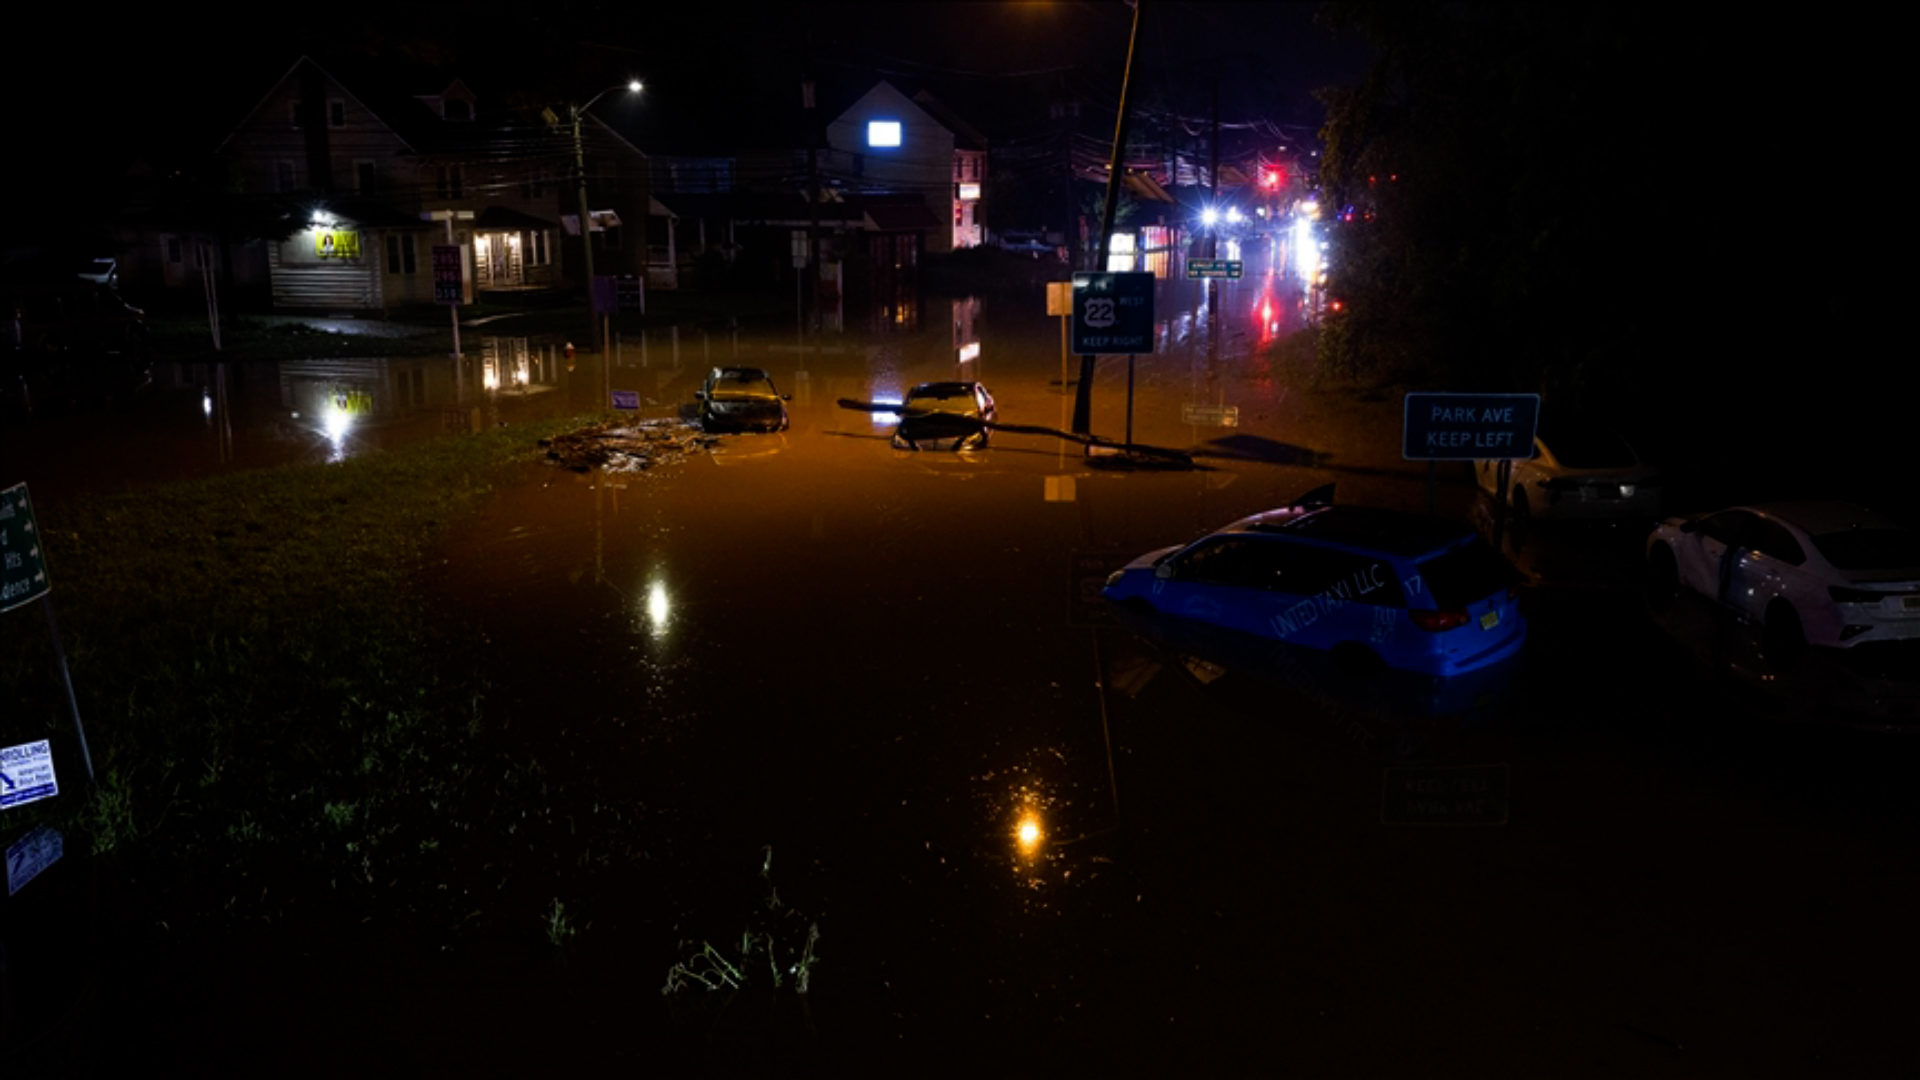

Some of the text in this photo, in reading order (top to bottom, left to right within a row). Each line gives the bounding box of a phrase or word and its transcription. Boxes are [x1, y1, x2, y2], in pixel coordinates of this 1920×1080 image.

[1119, 296, 1144, 307] WEST
[1087, 303, 1112, 321] 22
[1082, 336, 1143, 347] KEEP RIGHT
[1431, 404, 1514, 424] PARK AVE
[1426, 430, 1515, 448] KEEP LEFT
[1404, 574, 1422, 597] 17
[1269, 563, 1386, 639] UNITED TAXI LLC
